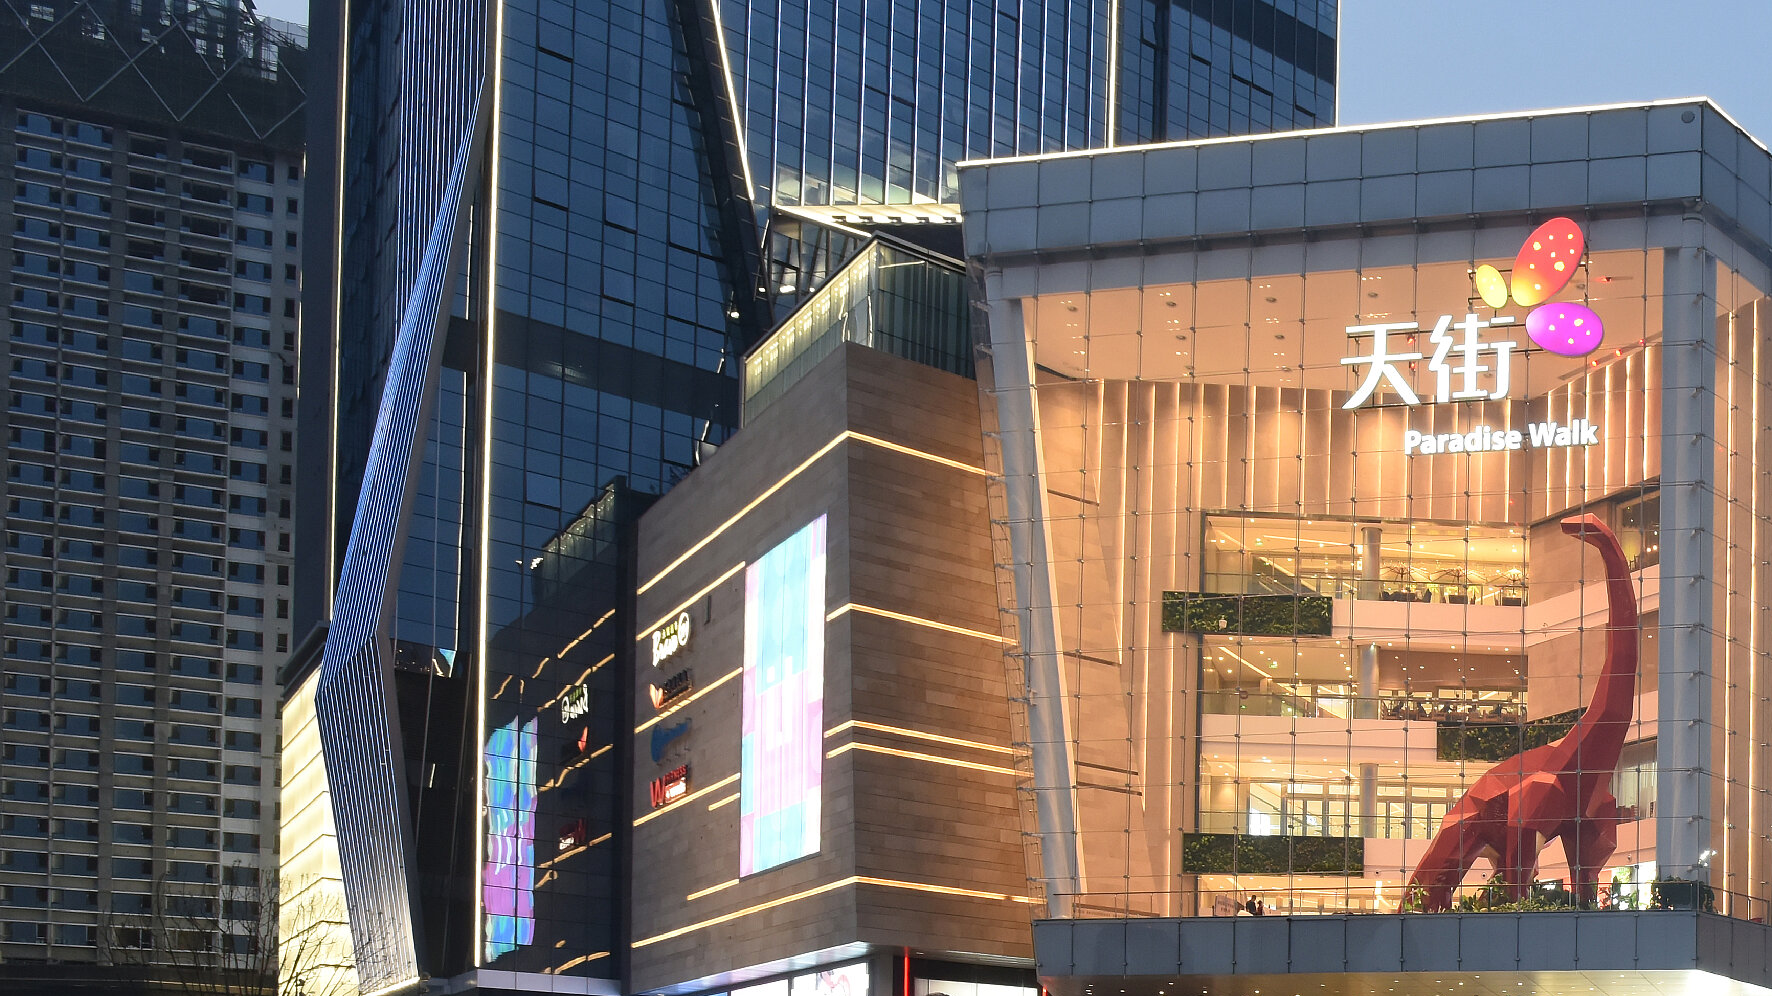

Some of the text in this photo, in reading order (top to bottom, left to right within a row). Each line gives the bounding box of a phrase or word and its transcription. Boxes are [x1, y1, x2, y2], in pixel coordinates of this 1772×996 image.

[1340, 313, 1518, 410] 天街
[1403, 418, 1600, 456] Paradise Walk
